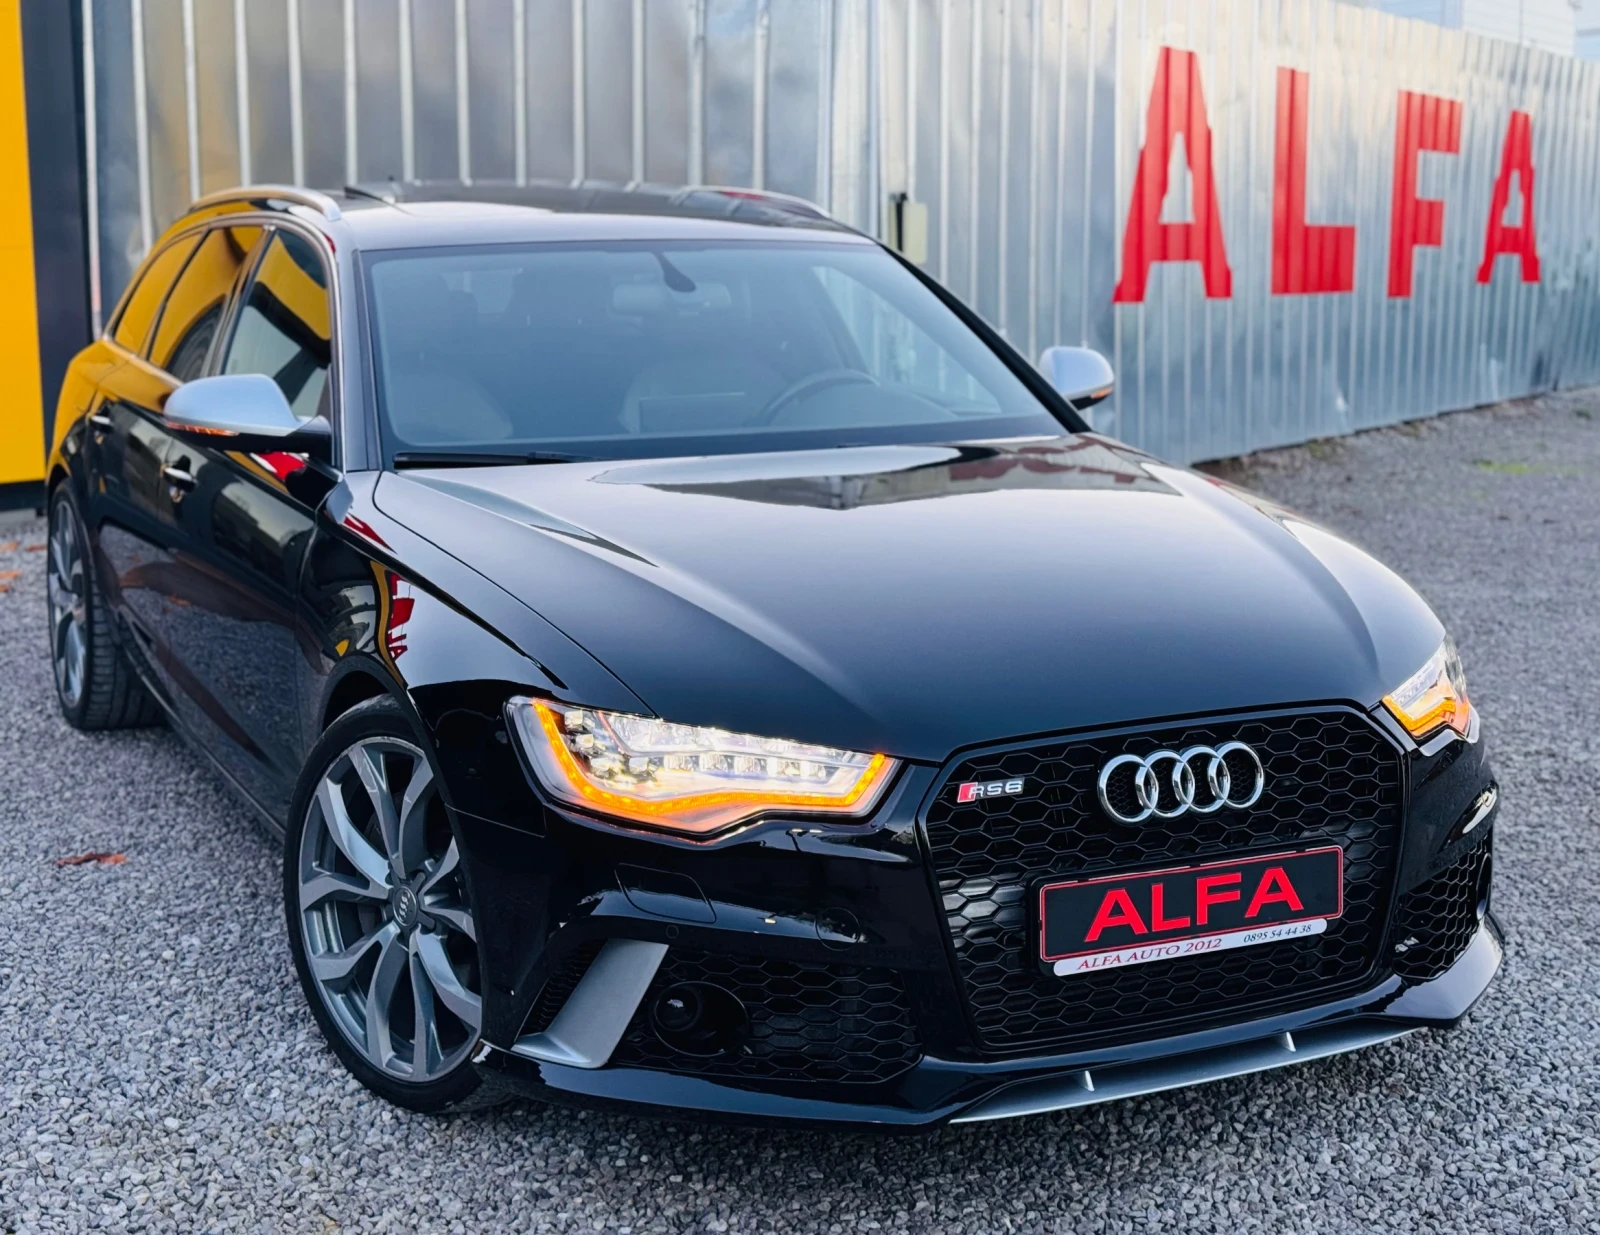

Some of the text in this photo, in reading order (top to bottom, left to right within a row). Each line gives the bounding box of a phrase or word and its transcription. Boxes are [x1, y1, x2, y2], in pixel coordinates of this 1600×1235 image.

[1112, 45, 1541, 304] ALFA
[967, 780, 1023, 799] RS6
[1084, 866, 1304, 942] ALFA
[1076, 924, 1312, 970] ALFA AUTO 2012 0895 54 44 38
